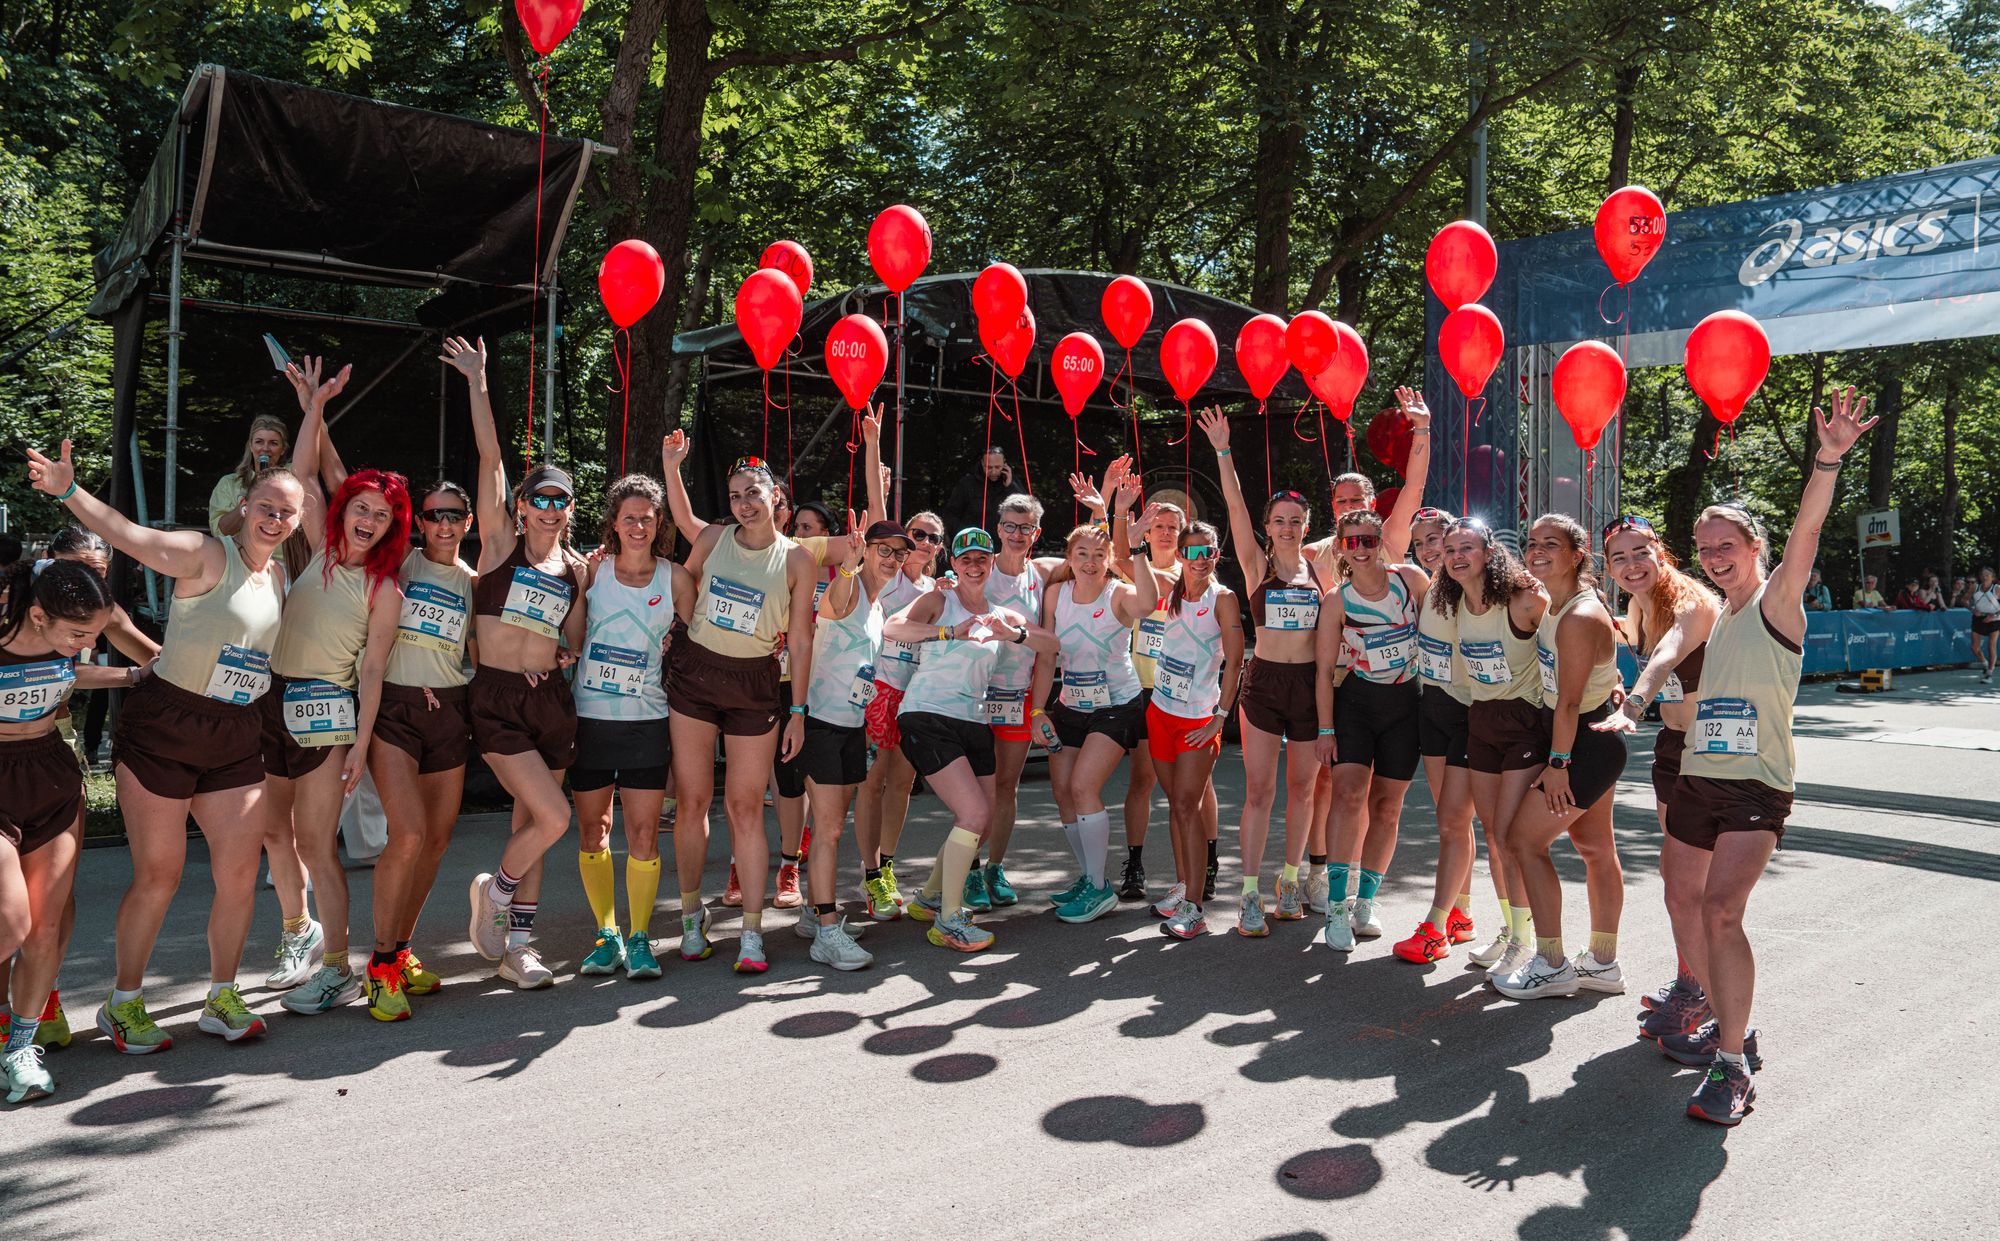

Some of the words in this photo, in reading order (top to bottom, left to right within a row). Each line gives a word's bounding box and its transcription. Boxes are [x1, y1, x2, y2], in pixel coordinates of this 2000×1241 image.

[831, 340, 866, 359] 60:00
[1063, 355, 1094, 373] 65:00
[1868, 516, 1887, 534] dm
[524, 589, 546, 606] 127
[553, 603, 565, 615] AA
[715, 599, 733, 615] 131
[742, 611, 756, 621] AA
[411, 602, 445, 623] 7632
[448, 616, 461, 628] AA
[1277, 607, 1297, 619] 134
[1304, 610, 1316, 618] AA
[1145, 635, 1162, 648] 135
[1380, 646, 1400, 660] 133
[1438, 661, 1449, 670] AA
[1493, 662, 1506, 671] AA
[223, 669, 257, 690] 7704
[599, 665, 617, 680] 161
[627, 674, 641, 684] AA
[1160, 671, 1171, 685] 138
[1177, 681, 1189, 691] AA
[1665, 679, 1679, 688] AA
[4, 688, 47, 705] 8251
[1070, 688, 1086, 698] 191
[1093, 687, 1105, 696] AA
[295, 702, 331, 718] 8031
[338, 705, 346, 714] A
[987, 703, 1003, 714] 139
[334, 734, 350, 742] 8031
[1704, 723, 1723, 737] 132
[1736, 727, 1754, 737] AA
